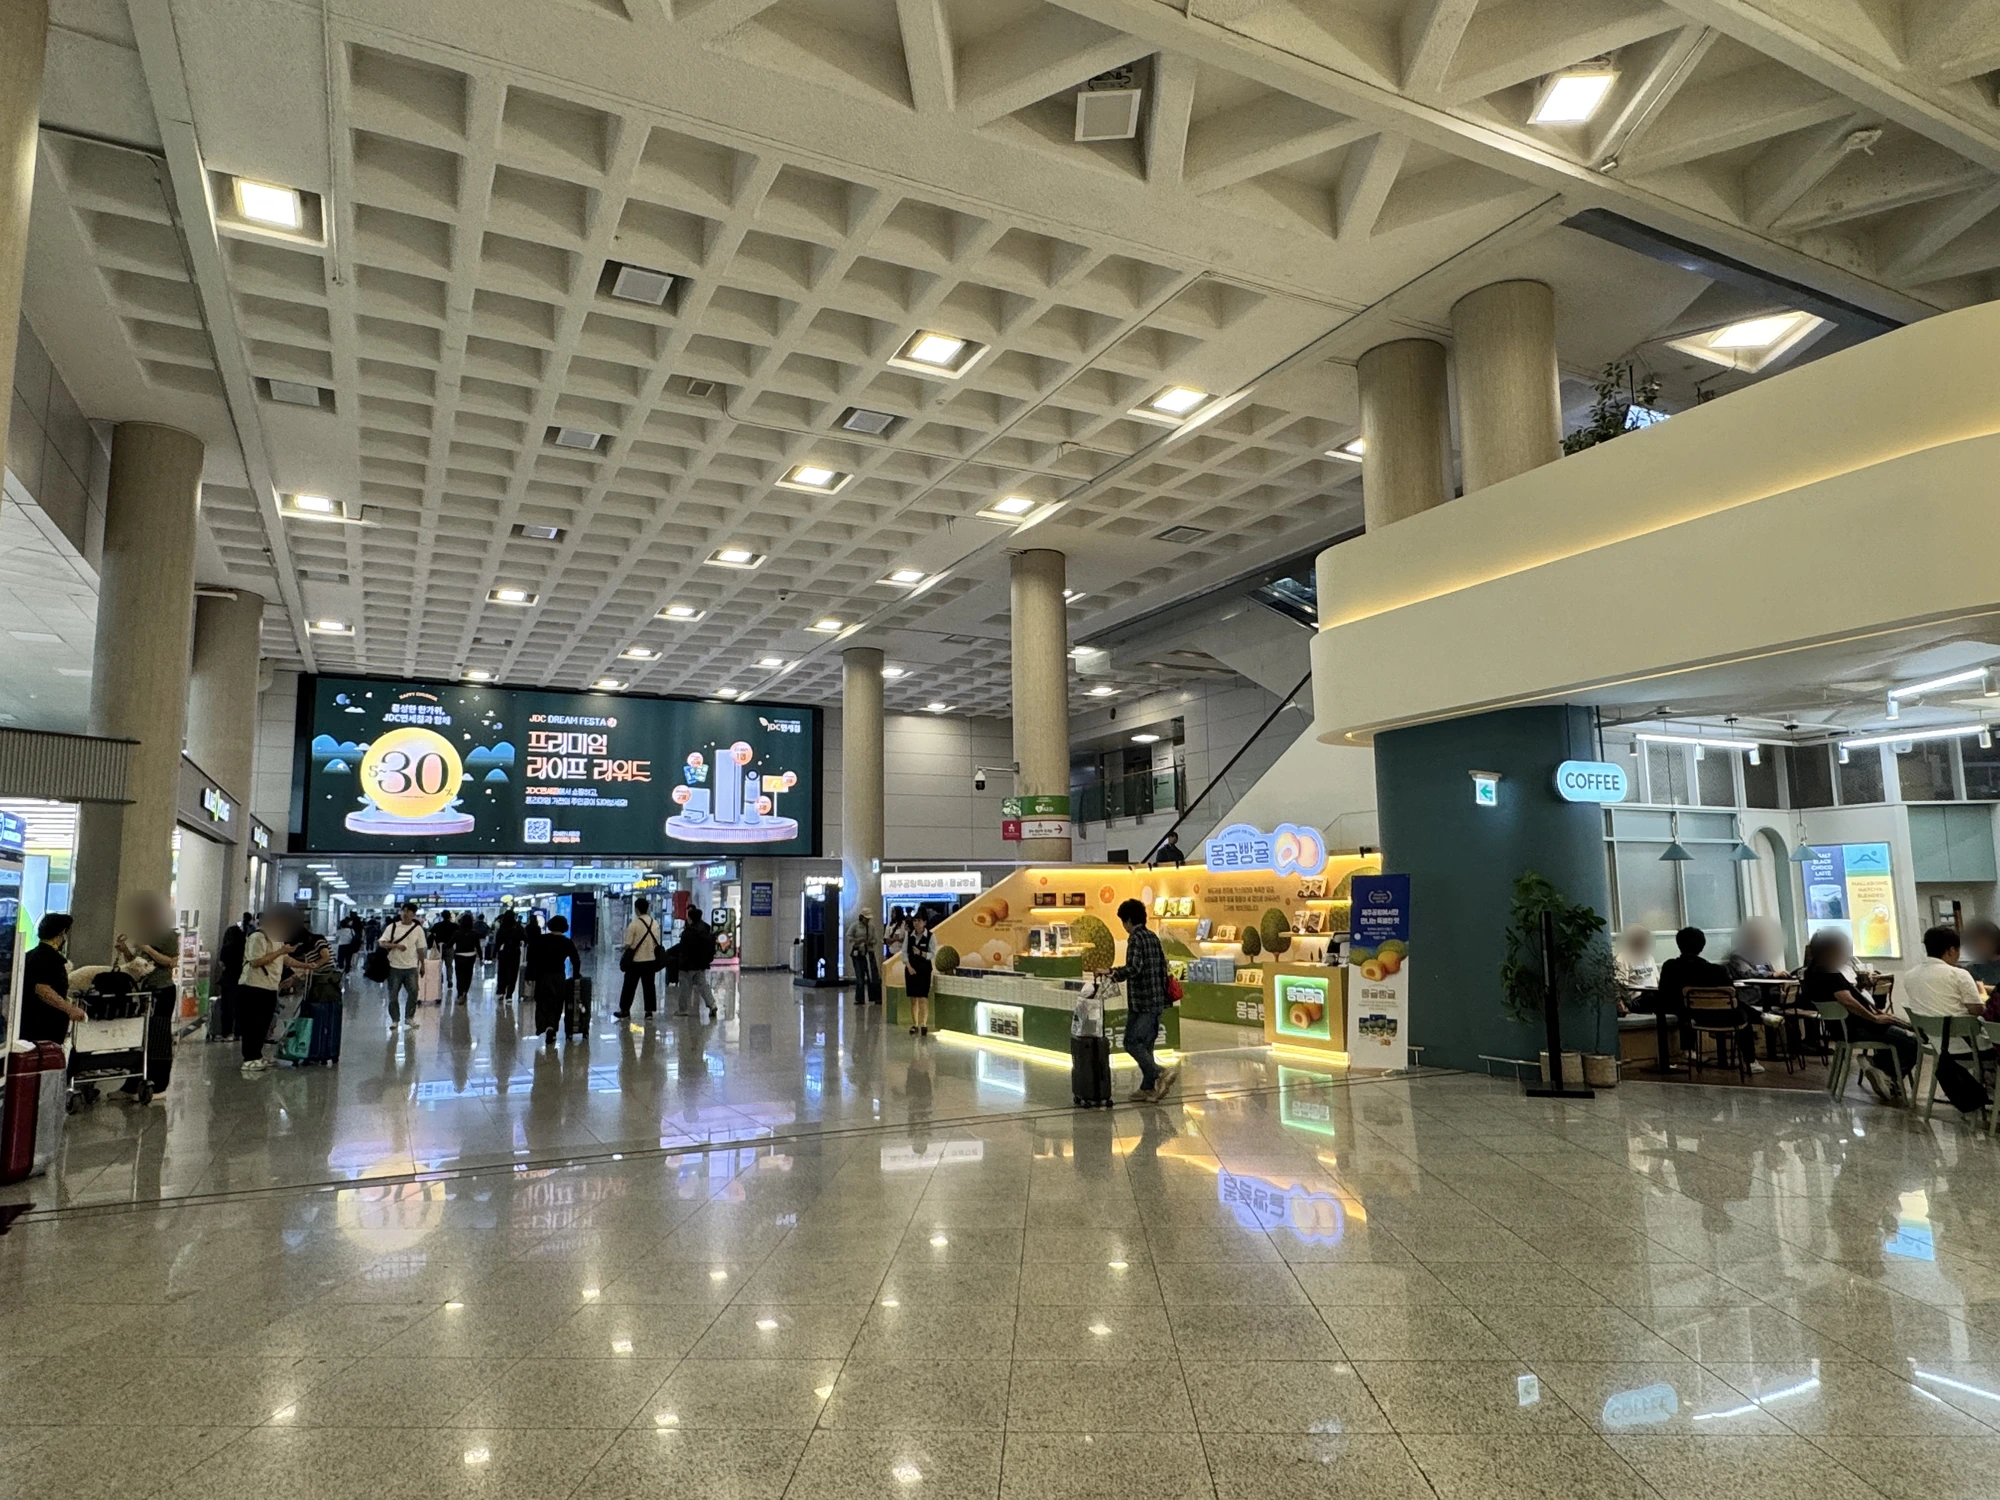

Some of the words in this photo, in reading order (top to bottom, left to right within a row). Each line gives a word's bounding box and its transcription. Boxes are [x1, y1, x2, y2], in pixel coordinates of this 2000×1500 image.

[529, 714, 547, 723] JDC
[548, 715, 578, 725] DREAM
[579, 717, 606, 726] FESTA
[528, 731, 607, 755] 프리미엄
[527, 757, 588, 779] 라이프
[593, 759, 652, 782] 리워드
[1565, 772, 1620, 791] COFFEE
[1211, 841, 1269, 867] 몽귤빵귤
